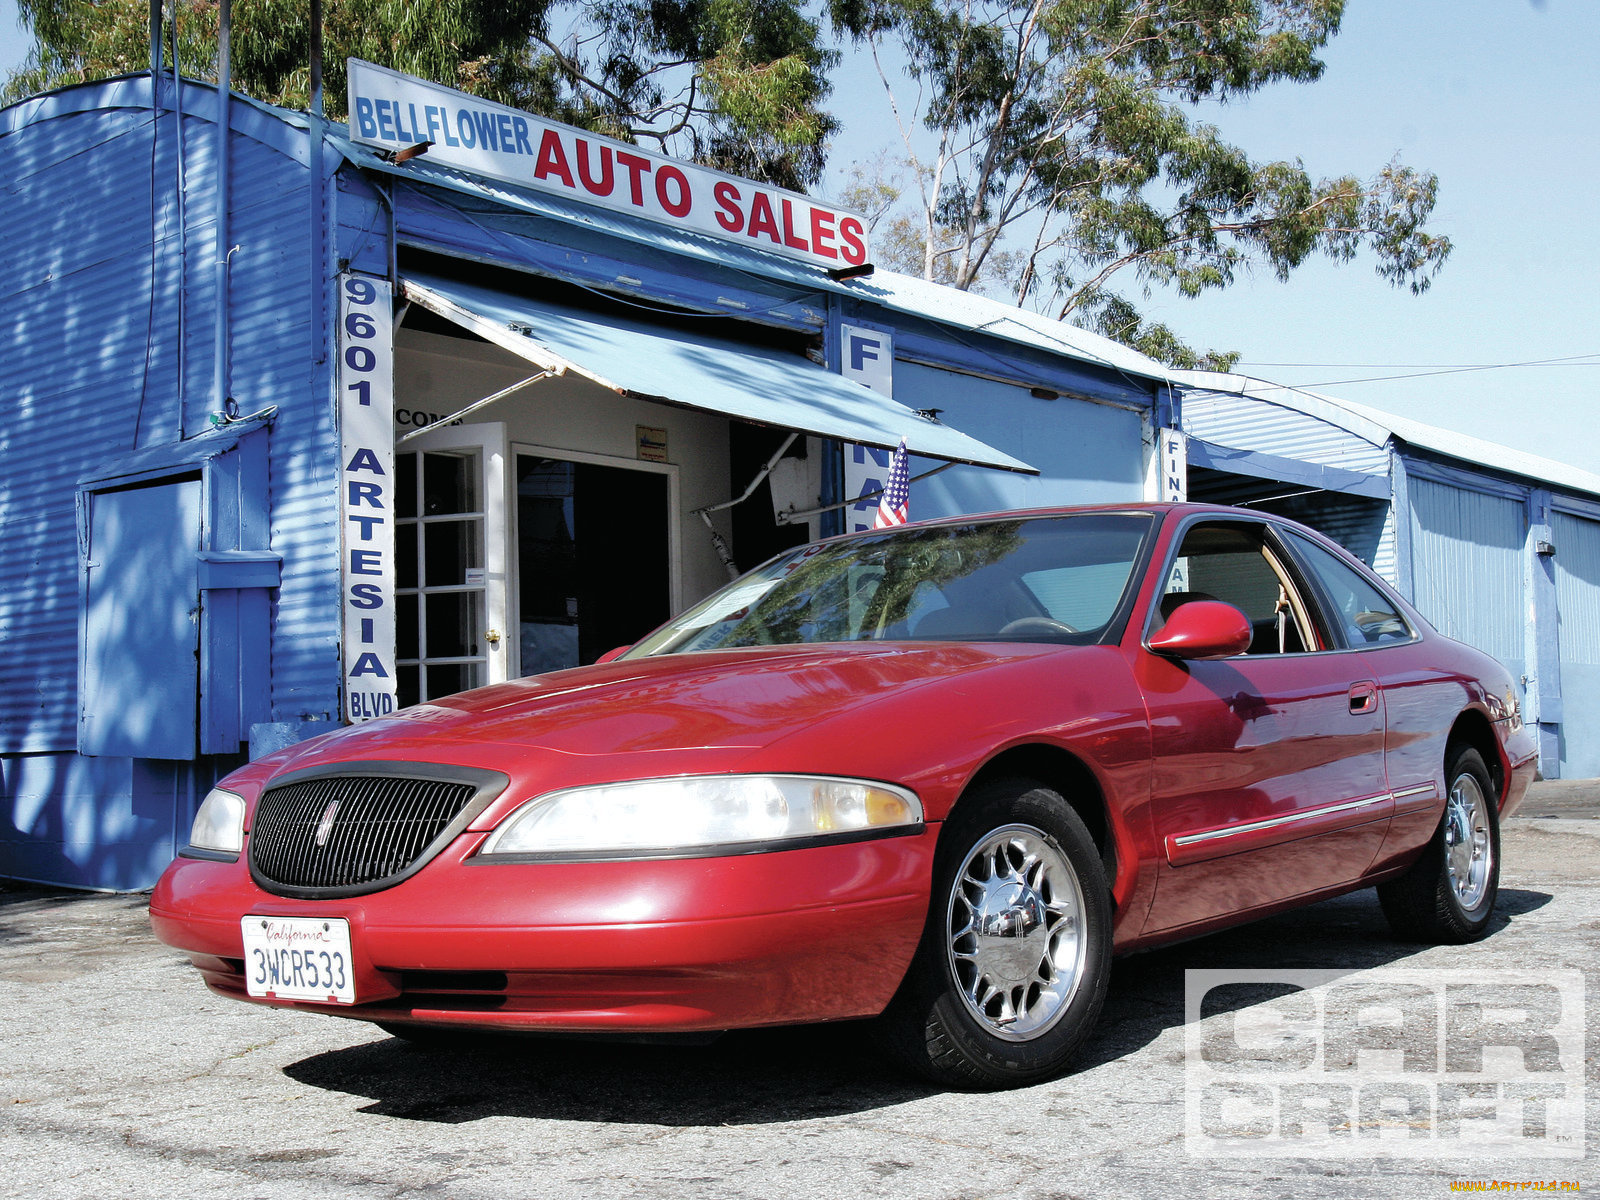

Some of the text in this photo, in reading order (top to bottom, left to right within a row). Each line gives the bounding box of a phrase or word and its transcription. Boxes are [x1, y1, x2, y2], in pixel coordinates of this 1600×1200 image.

[355, 97, 867, 265] BELLFLOWER AUTO SALES
[344, 279, 389, 678] 9601 ARTESIA
[351, 692, 393, 718] BLVD
[266, 922, 331, 946] California
[253, 948, 346, 990] 3WCR533
